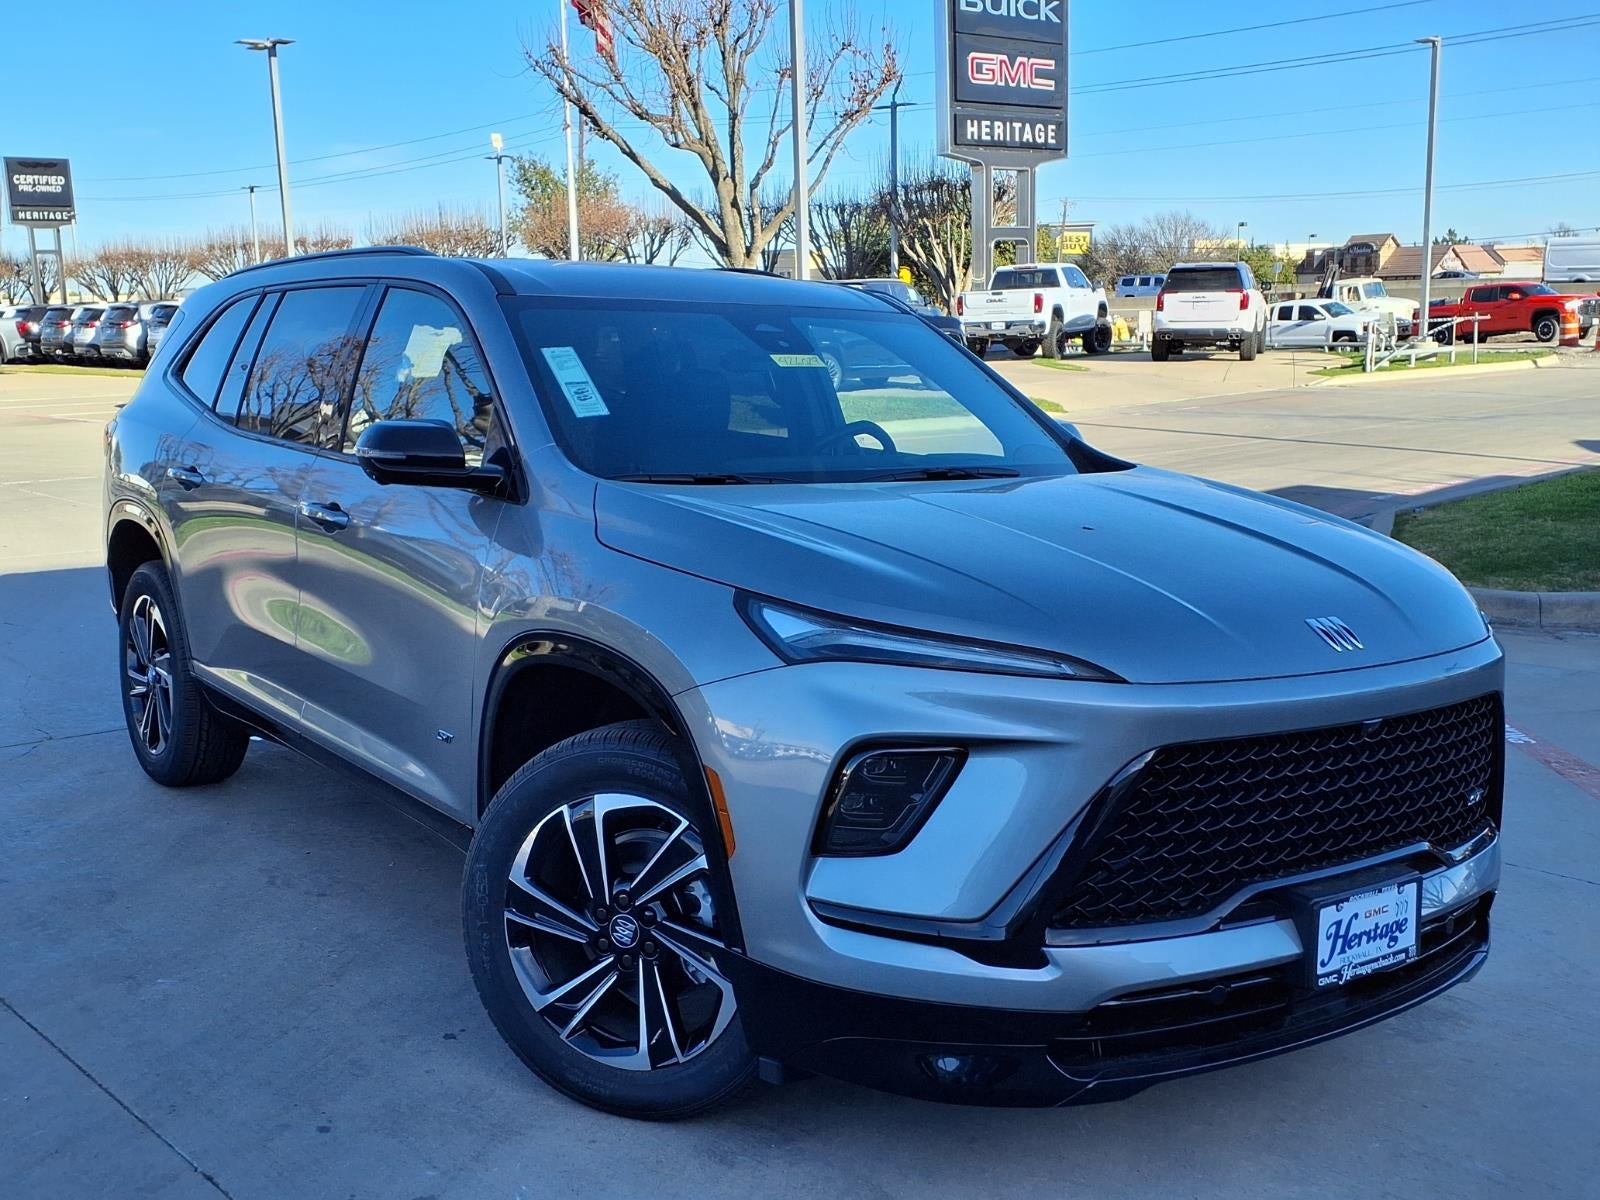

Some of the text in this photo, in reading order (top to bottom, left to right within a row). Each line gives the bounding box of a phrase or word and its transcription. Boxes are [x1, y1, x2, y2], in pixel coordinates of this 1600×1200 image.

[968, 52, 1055, 90] GMC
[966, 118, 1056, 144] HERITAGE
[13, 174, 65, 185] CERTIFIED
[18, 210, 69, 220] HERITAGE
[1364, 904, 1390, 919] GMC
[1320, 912, 1408, 967] Heritage
[1318, 974, 1339, 986] GMC
